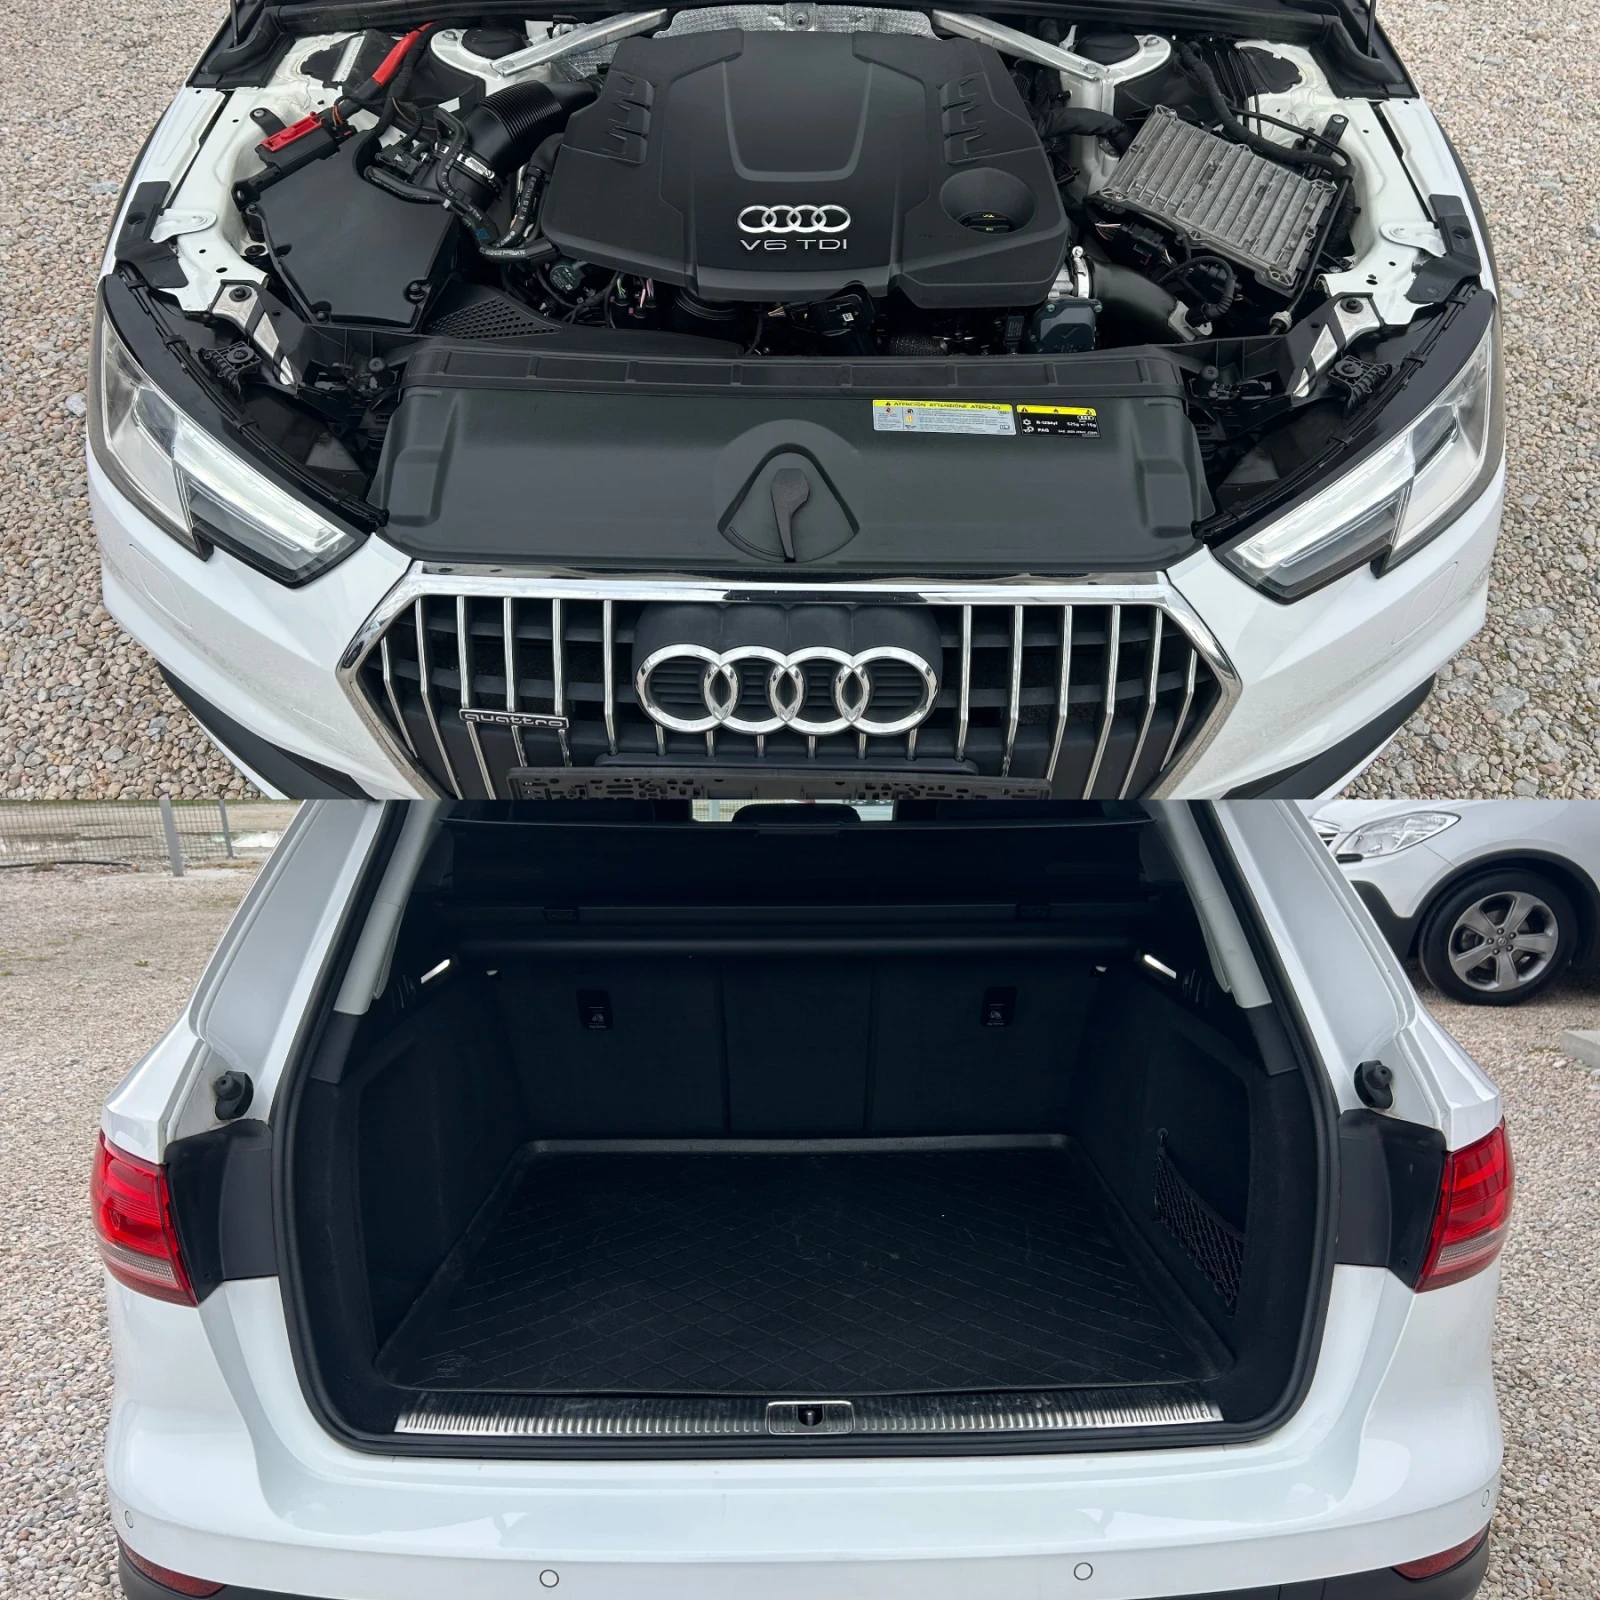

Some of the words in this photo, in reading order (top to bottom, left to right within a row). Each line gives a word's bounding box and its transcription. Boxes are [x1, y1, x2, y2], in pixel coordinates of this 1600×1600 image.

[740, 239, 787, 250] V6
[796, 239, 847, 250] TDI
[464, 713, 563, 727] quattro
